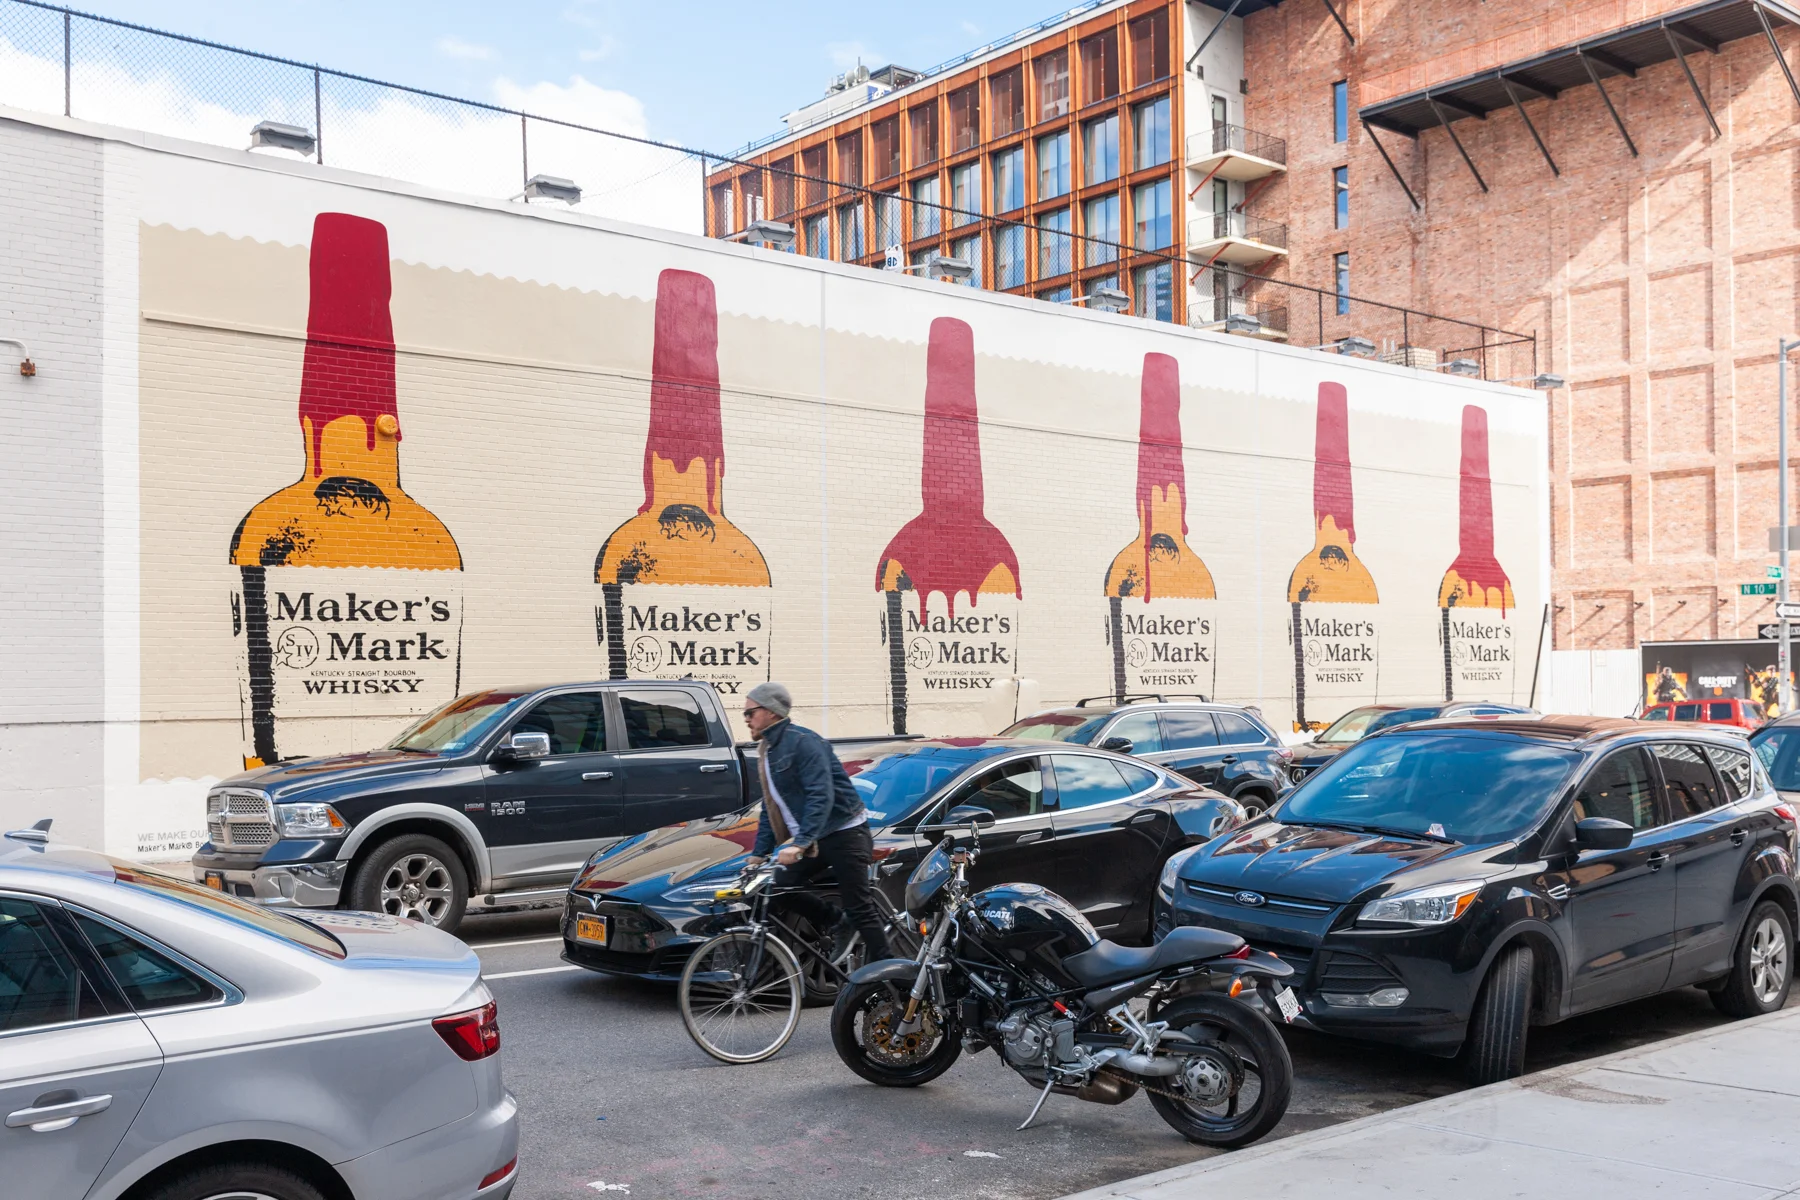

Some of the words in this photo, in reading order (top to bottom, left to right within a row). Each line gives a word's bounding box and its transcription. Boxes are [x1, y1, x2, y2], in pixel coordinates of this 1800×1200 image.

[1743, 585, 1751, 594] N
[1754, 584, 1765, 594] 10
[272, 591, 451, 622] Maker's
[627, 605, 762, 632] Maker's
[906, 610, 1011, 634] Maker's
[1124, 614, 1210, 636] Maker's
[1303, 618, 1374, 637] Maker's
[1451, 621, 1511, 639] Maker's
[666, 640, 760, 666] Mark
[937, 641, 1010, 664] Mark
[1151, 642, 1210, 662] Mark
[1324, 643, 1373, 662] Mark
[1469, 645, 1511, 662] Mark
[922, 677, 995, 689] WHISKY
[1139, 674, 1198, 686] WHISKY
[1315, 673, 1364, 683] WHISKY
[1461, 672, 1503, 681] WHISKY
[303, 679, 424, 694] WHISKY
[491, 801, 526, 809] RAM
[491, 807, 526, 816] 1500
[137, 833, 155, 842] WE
[157, 830, 187, 841] MAKE
[137, 844, 167, 852] Maker's
[1239, 892, 1257, 904] Ford
[979, 910, 1011, 919] DUCATI
